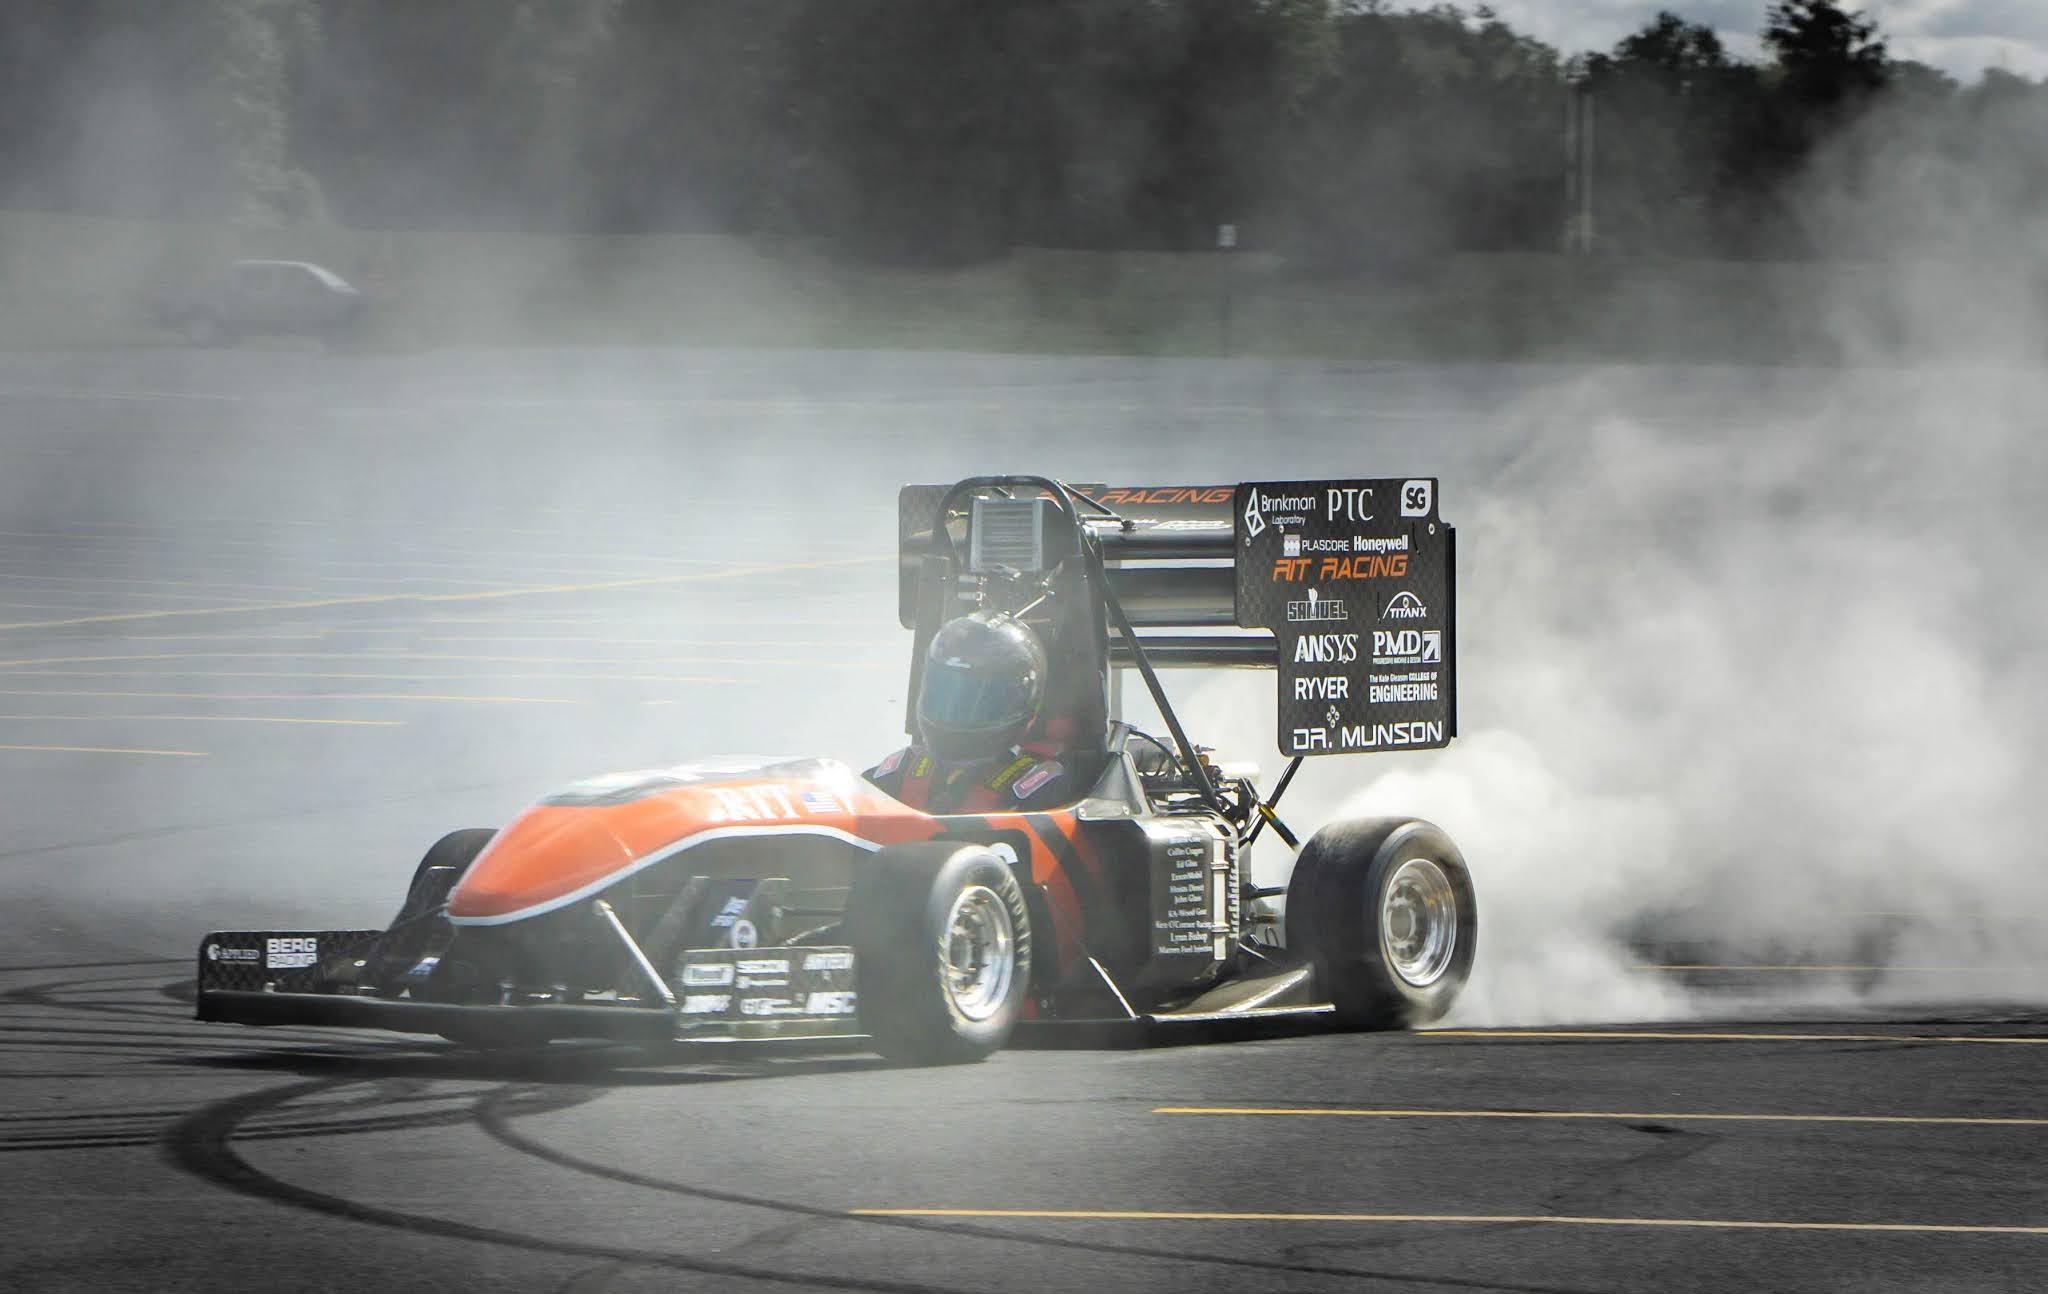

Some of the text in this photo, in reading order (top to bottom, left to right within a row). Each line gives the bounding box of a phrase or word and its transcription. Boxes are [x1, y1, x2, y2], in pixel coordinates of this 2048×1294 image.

[1099, 488, 1235, 504] RACING
[1261, 495, 1316, 512] Brinkman
[1328, 488, 1374, 522] PTC
[1405, 487, 1426, 510] SG
[1272, 515, 1306, 526] Laboratory
[1302, 539, 1349, 551] PLASCORE
[1354, 534, 1408, 554] Honeywell
[1272, 555, 1409, 583] RIT RACING
[1288, 600, 1348, 622] SAMUEL
[1294, 634, 1358, 663] ANSYS
[1373, 630, 1421, 656] PMD
[1409, 672, 1430, 682] COLLEGE
[1431, 672, 1438, 681] OF
[1295, 677, 1349, 700] RYVER
[1369, 683, 1438, 703] ENGINEERING
[1293, 721, 1442, 750] DR. MUNSON
[266, 938, 317, 953] BERG
